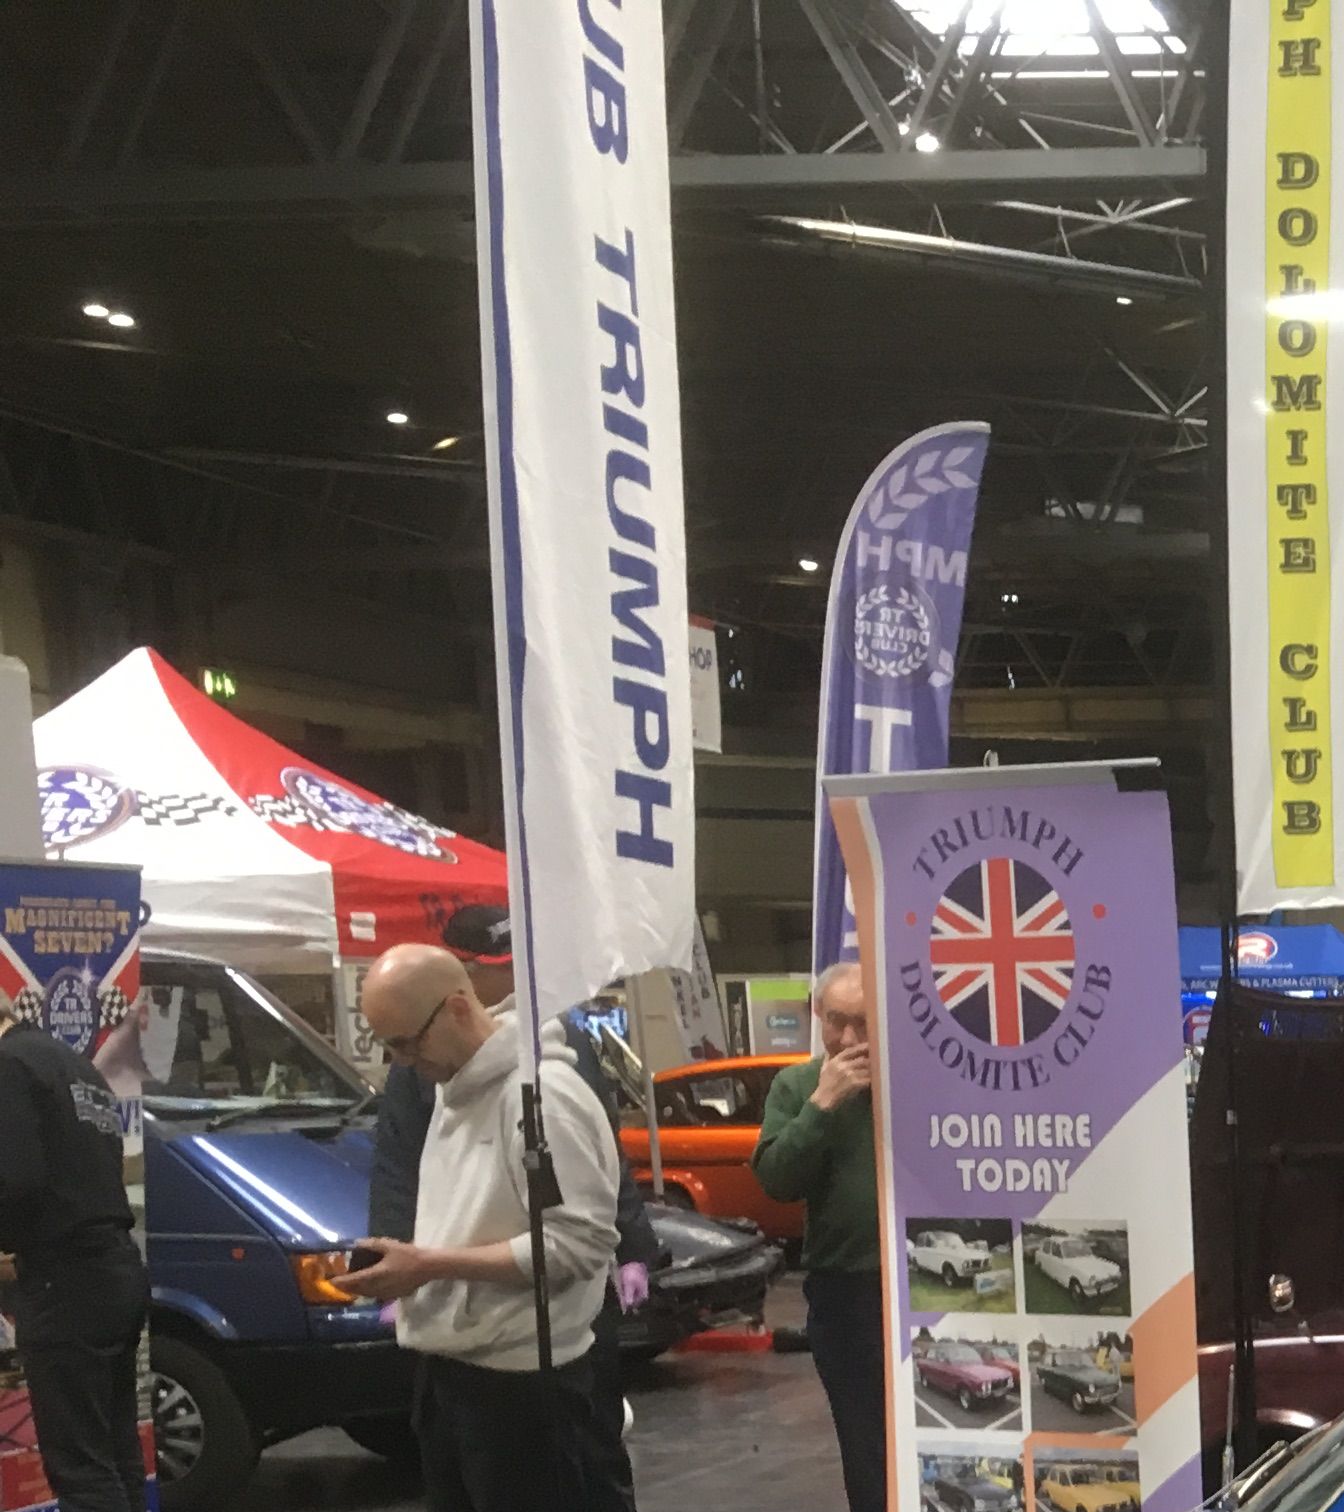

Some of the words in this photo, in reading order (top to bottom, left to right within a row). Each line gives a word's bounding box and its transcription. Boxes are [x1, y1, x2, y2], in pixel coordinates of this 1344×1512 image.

[1271, 152, 1322, 573] DOLOMITE
[594, 226, 674, 868] TRIUMPH
[1279, 643, 1322, 835] CLUB
[912, 806, 1085, 882] TRIUMPH
[900, 960, 1051, 1091] DOLOMITE
[1053, 962, 1113, 1067] CLUB
[930, 1113, 1002, 1148] JOIN
[1012, 1113, 1092, 1148] HERE
[956, 1158, 1070, 1193] TODAY
